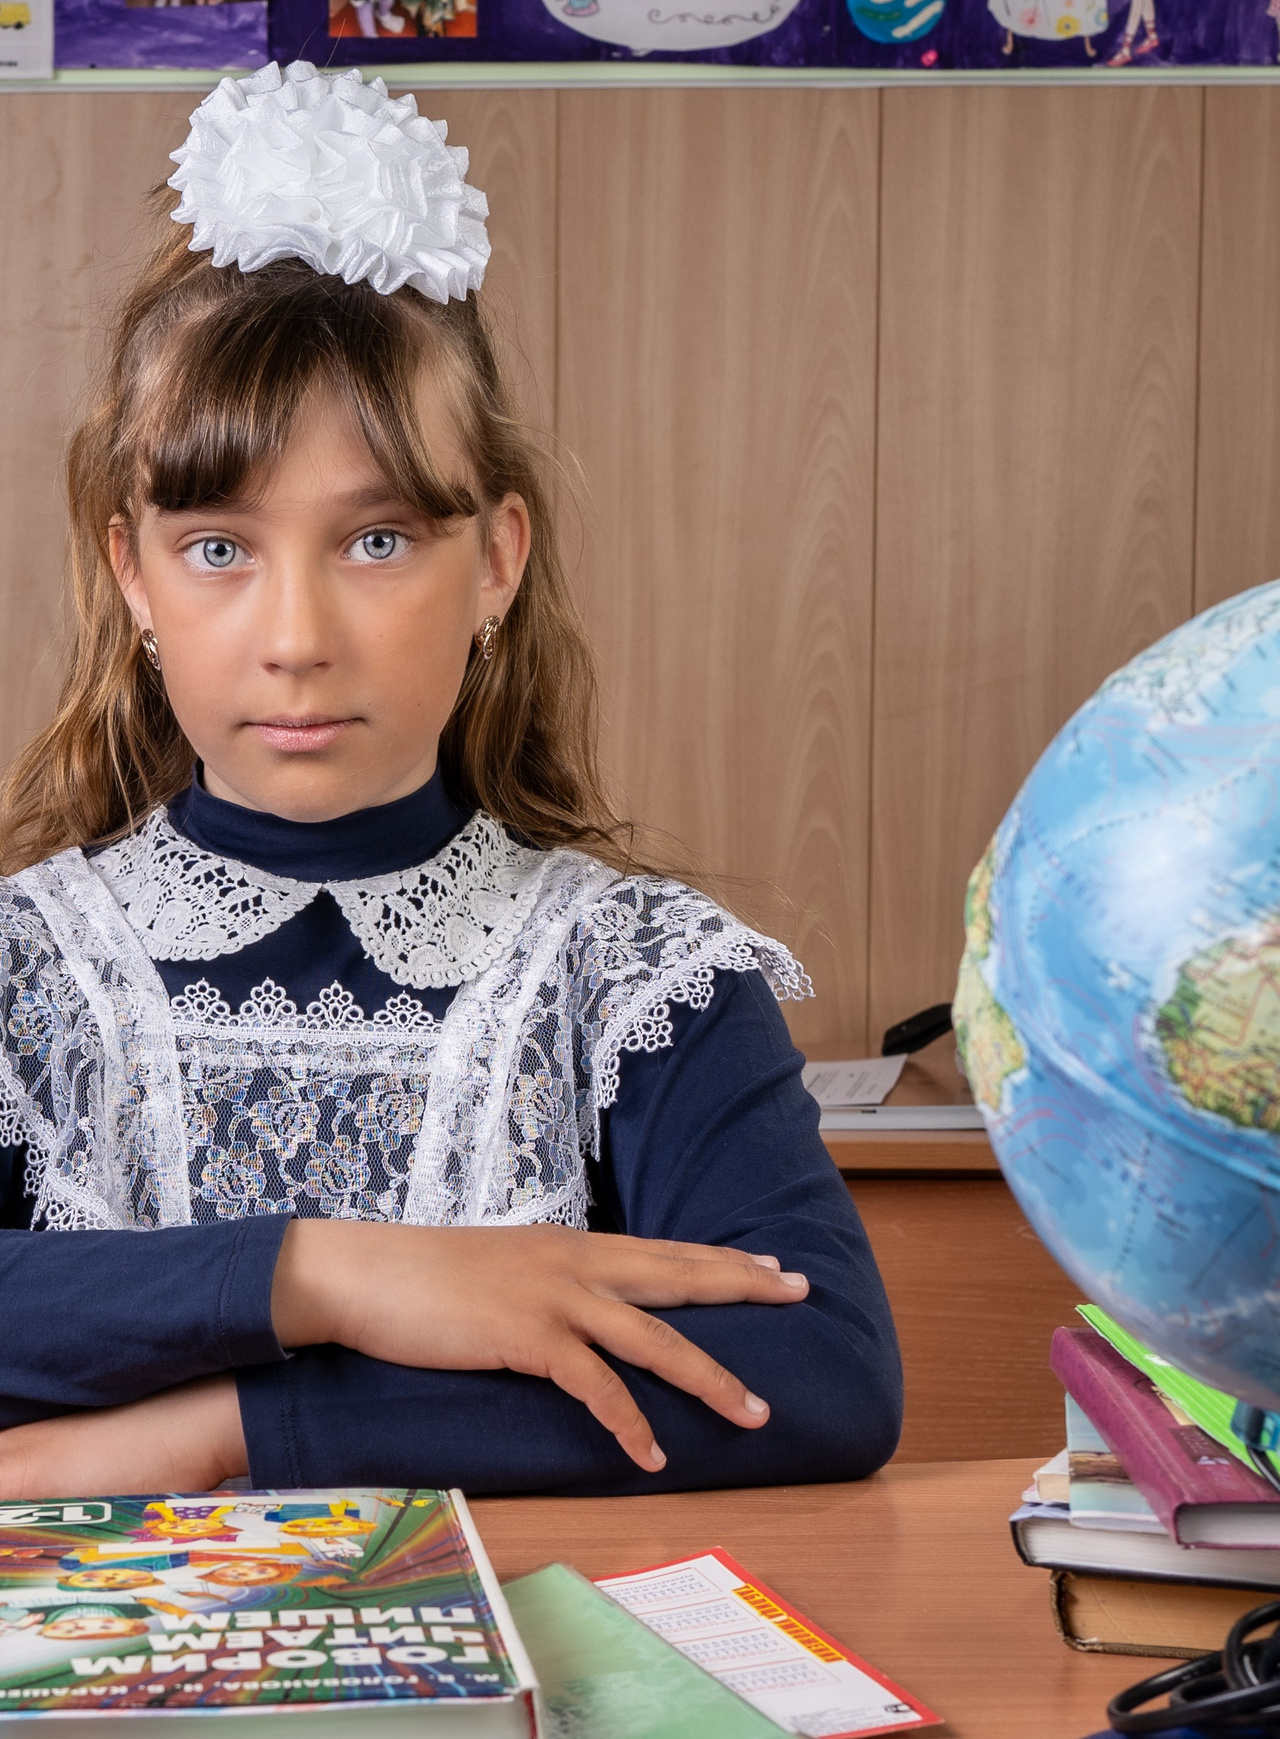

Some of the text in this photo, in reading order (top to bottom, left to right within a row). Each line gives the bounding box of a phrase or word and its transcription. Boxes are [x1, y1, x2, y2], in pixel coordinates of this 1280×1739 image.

[732, 1583, 789, 1618] ТАБЛИЦА
[158, 1606, 476, 1631] ПИШЕМ
[147, 1625, 485, 1651] ЧИТАЕМ
[70, 1645, 490, 1676] ГОВОРИМ
[175, 1682, 204, 1693] Н.
[214, 1675, 419, 1691] ГОЛОВАНОВА,
